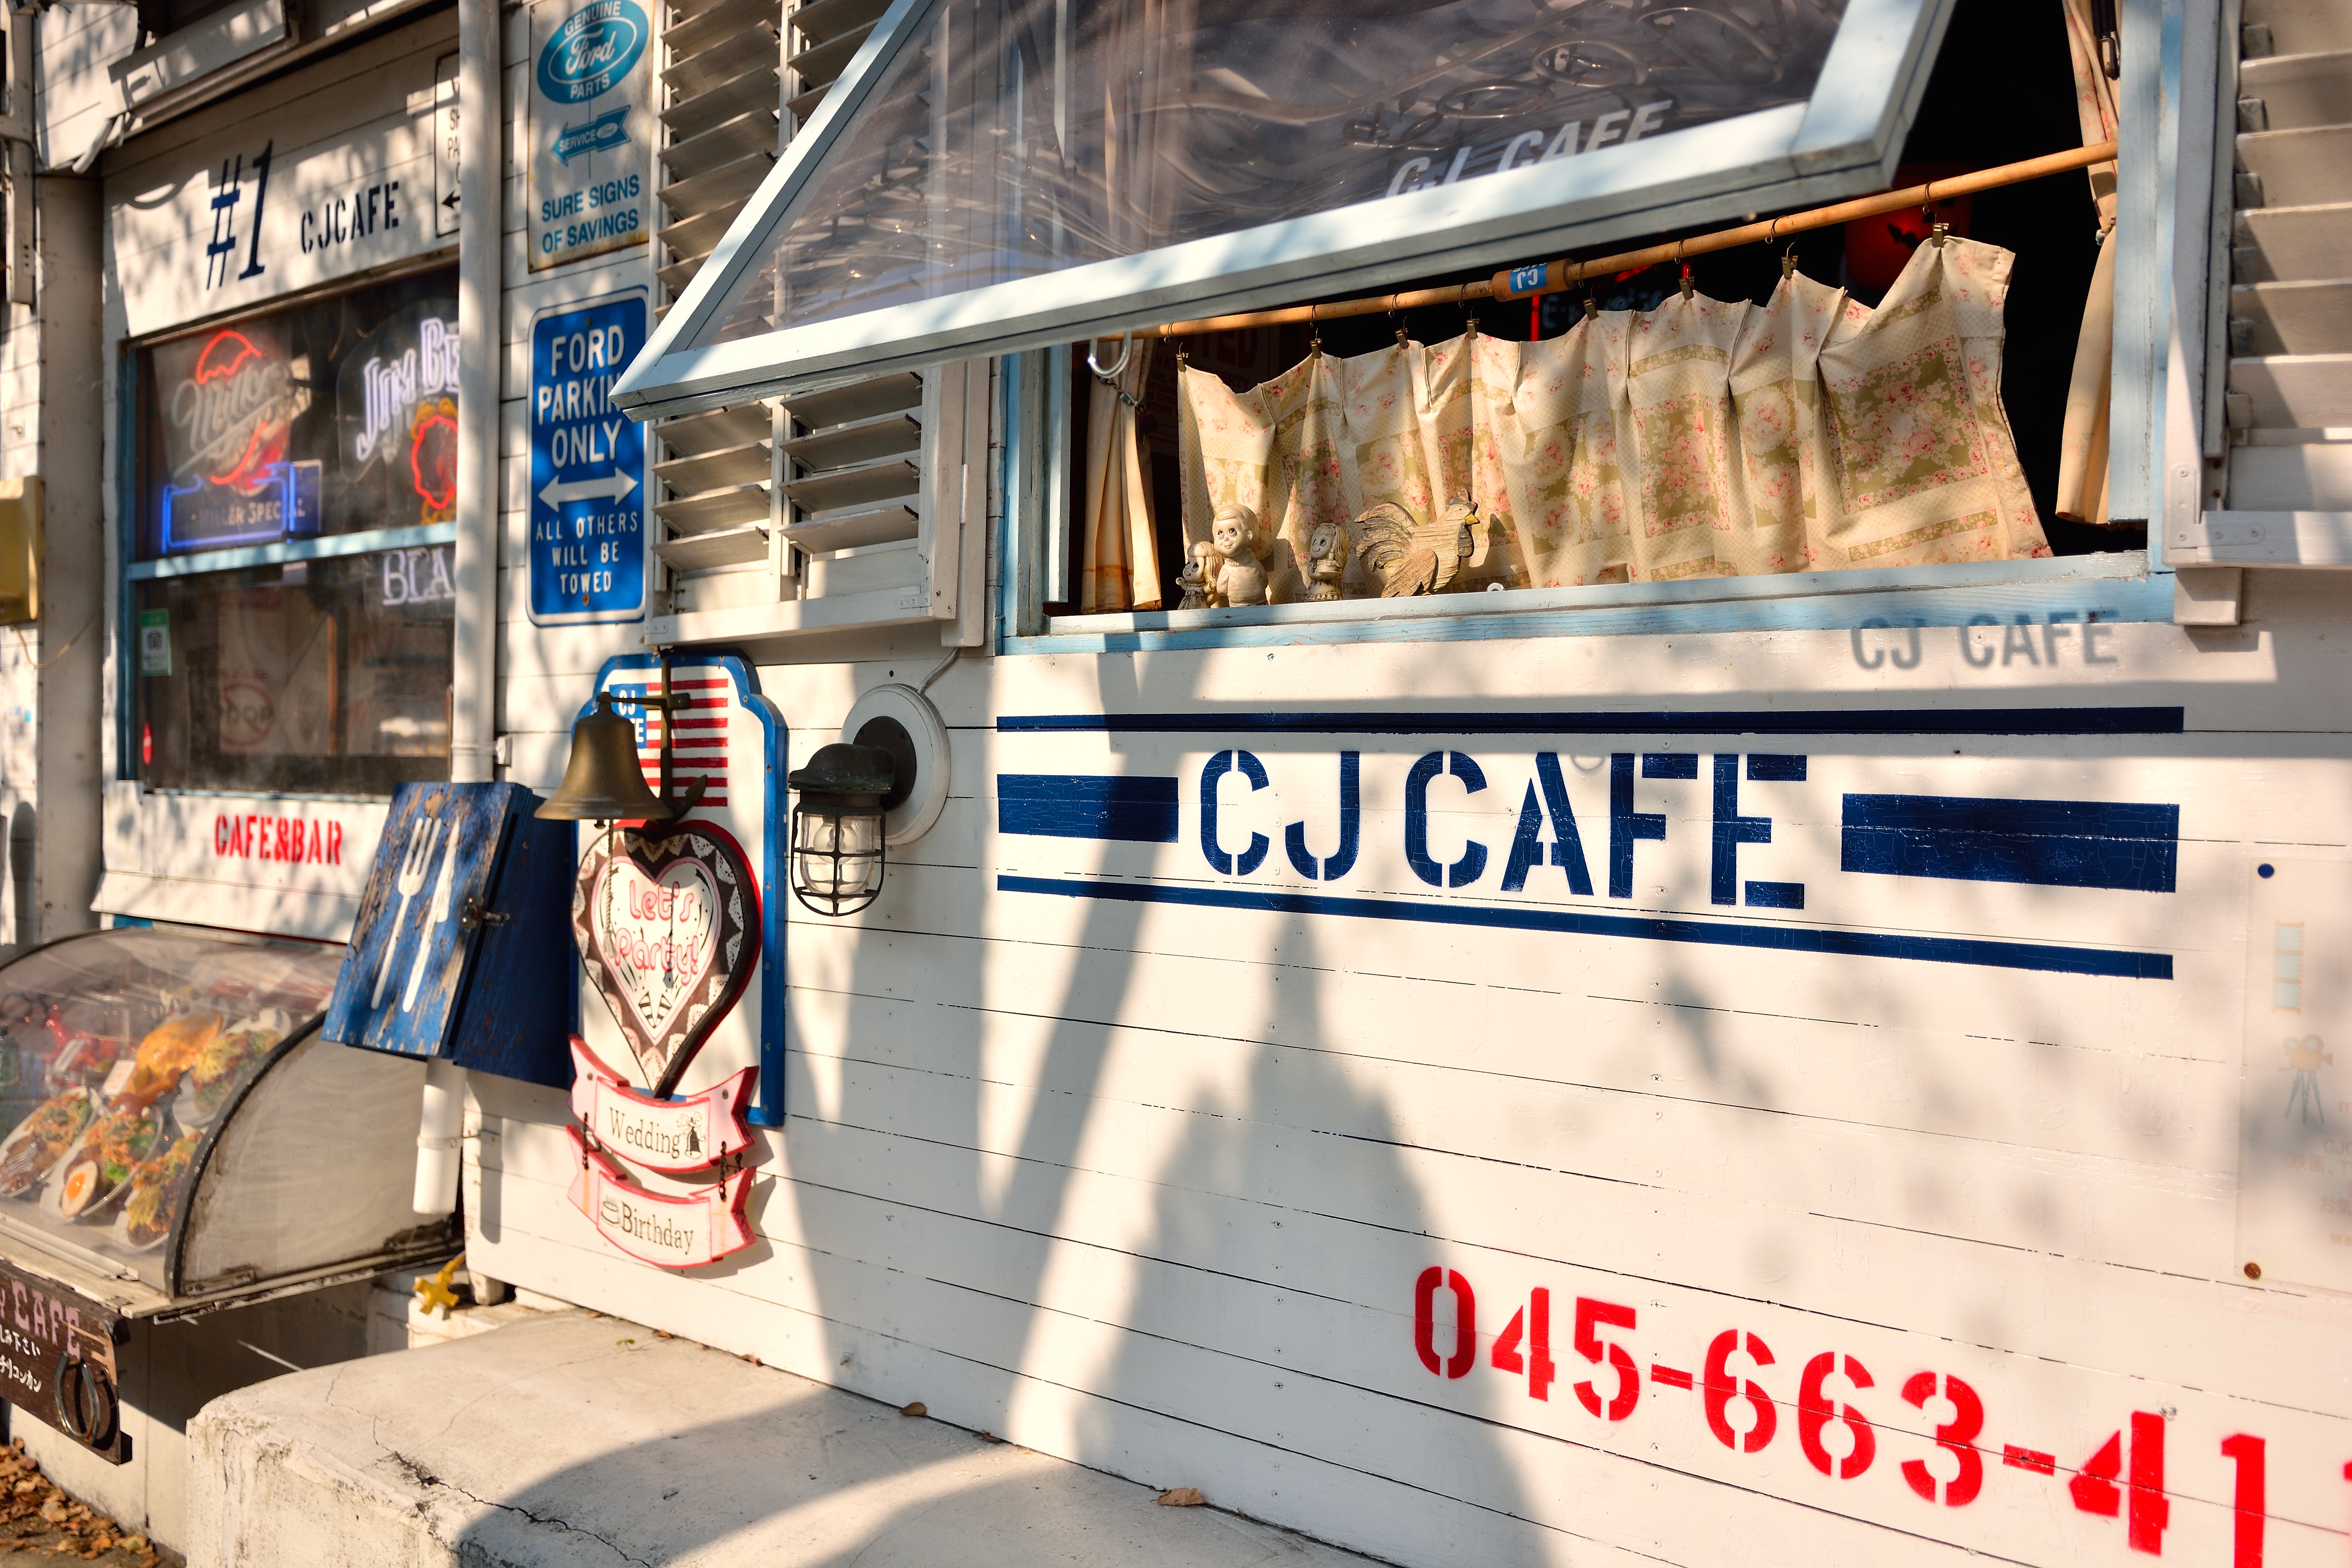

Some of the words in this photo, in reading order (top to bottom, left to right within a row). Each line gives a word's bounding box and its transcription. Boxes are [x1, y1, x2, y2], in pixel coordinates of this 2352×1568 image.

[564, 0, 621, 35] GENUINE
[565, 27, 617, 76] Ford
[570, 74, 610, 100] PARTS
[559, 129, 596, 153] SERVICE
[207, 140, 273, 290] #1
[541, 191, 583, 223] SURE
[589, 174, 640, 208] SIGNS
[542, 229, 562, 254] OF
[568, 208, 639, 247] SAVINGS
[1517, 269, 1538, 289] CJ
[551, 324, 624, 377] FORD
[538, 371, 622, 425] PARKIN
[552, 419, 622, 469] ONLY
[536, 518, 562, 542] ALL
[575, 511, 637, 536] OTHERS
[552, 546, 588, 568] WILL
[600, 542, 619, 564] BE
[560, 571, 612, 595] TOWED
[1851, 617, 1926, 671] CJ
[1960, 610, 2120, 669] CAFE
[619, 690, 635, 715] CJ
[214, 814, 342, 866] CAFE&BAR
[1200, 750, 1360, 882] CJ
[1405, 749, 1808, 910] CAFE
[629, 880, 695, 922] Let's
[615, 927, 699, 986] Party!
[610, 1107, 681, 1159] Wedding
[621, 1201, 694, 1255] Birthday
[11, 1279, 81, 1361] CAFE
[1415, 1265, 2352, 1568] 045-663-41
